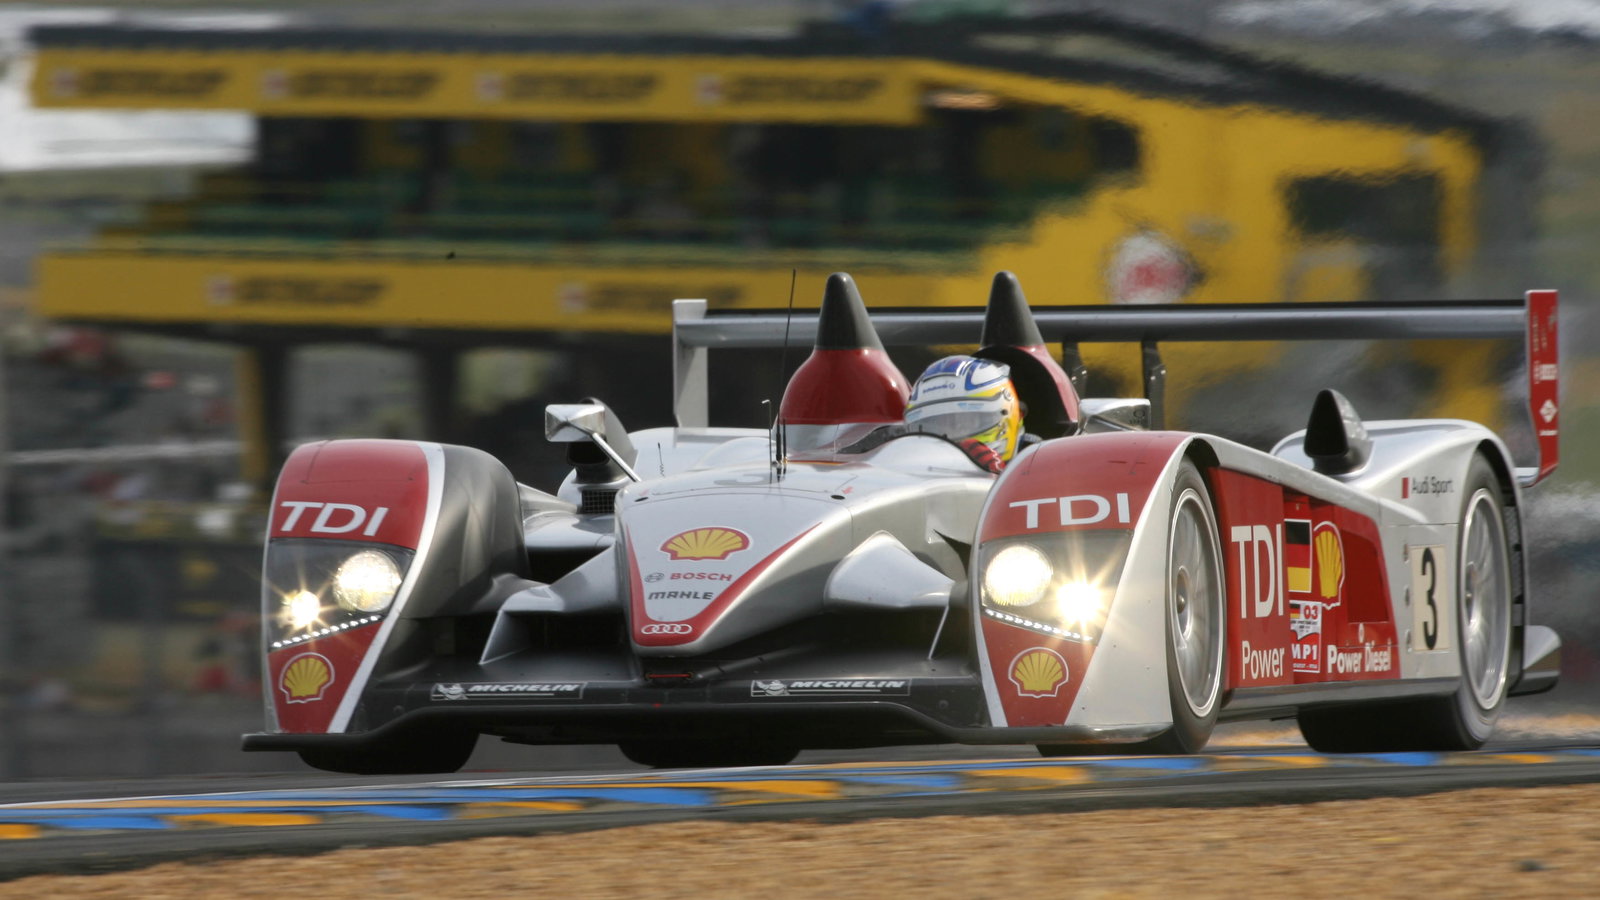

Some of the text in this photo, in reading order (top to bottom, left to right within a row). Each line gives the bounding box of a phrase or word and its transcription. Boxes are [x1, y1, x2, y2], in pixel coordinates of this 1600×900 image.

[1412, 476, 1454, 497] Audi Sport
[280, 500, 389, 537] TDI
[1009, 492, 1131, 529] TDI
[670, 572, 733, 581] BOSCH
[1231, 523, 1284, 619] TDI
[648, 591, 713, 600] MAHLE
[1303, 605, 1319, 619] 03
[1421, 547, 1438, 650] 3
[1242, 640, 1285, 680] Power
[1327, 638, 1391, 674] Power Diesel
[468, 684, 580, 692] MICHELIN
